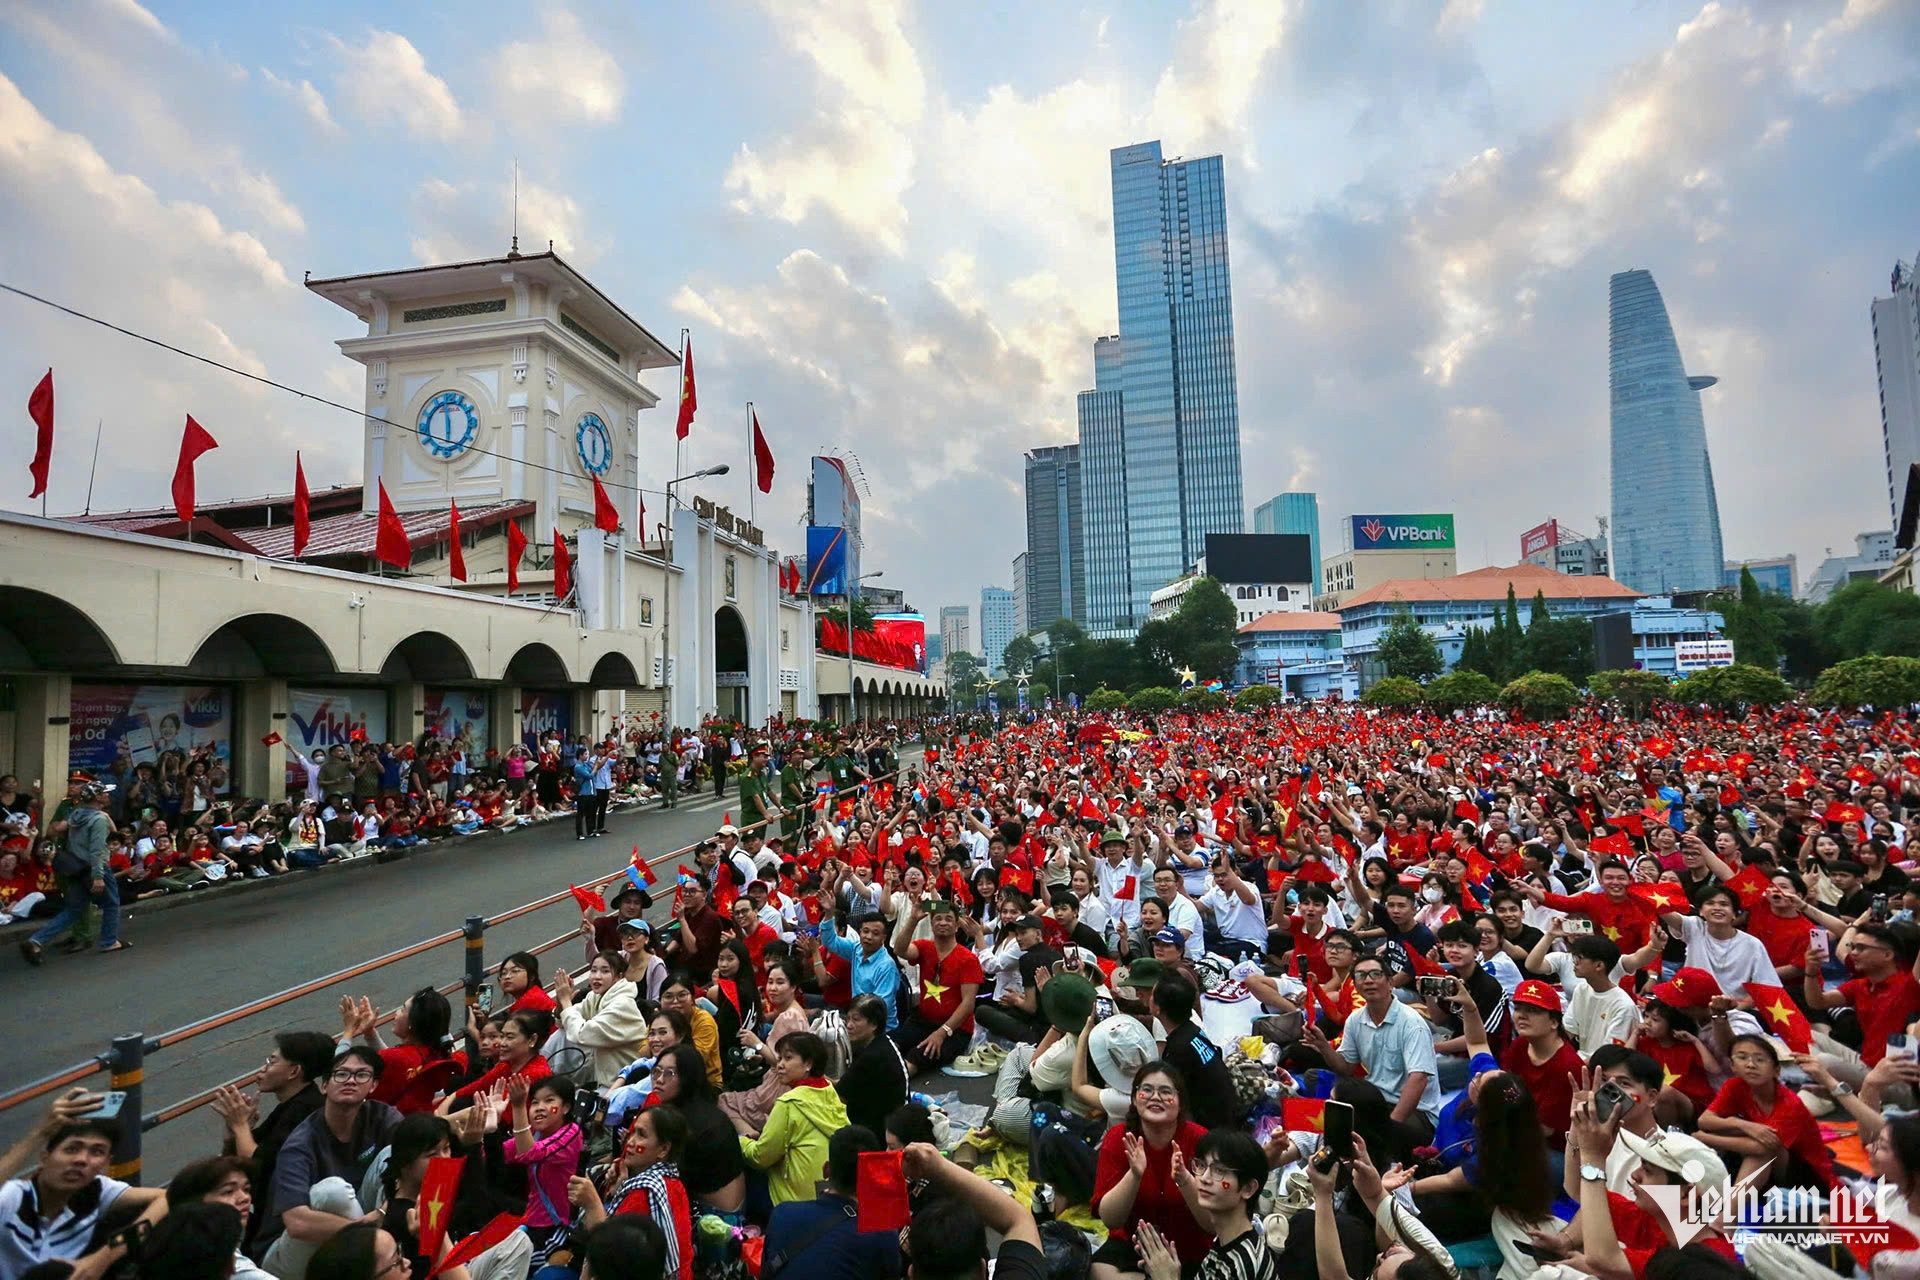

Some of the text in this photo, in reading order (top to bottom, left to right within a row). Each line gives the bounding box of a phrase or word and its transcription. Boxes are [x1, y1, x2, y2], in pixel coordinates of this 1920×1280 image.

[1387, 526, 1448, 542] VPBank
[188, 693, 220, 714] Vikki
[521, 696, 558, 734] Vikki
[290, 698, 366, 746] Vikki
